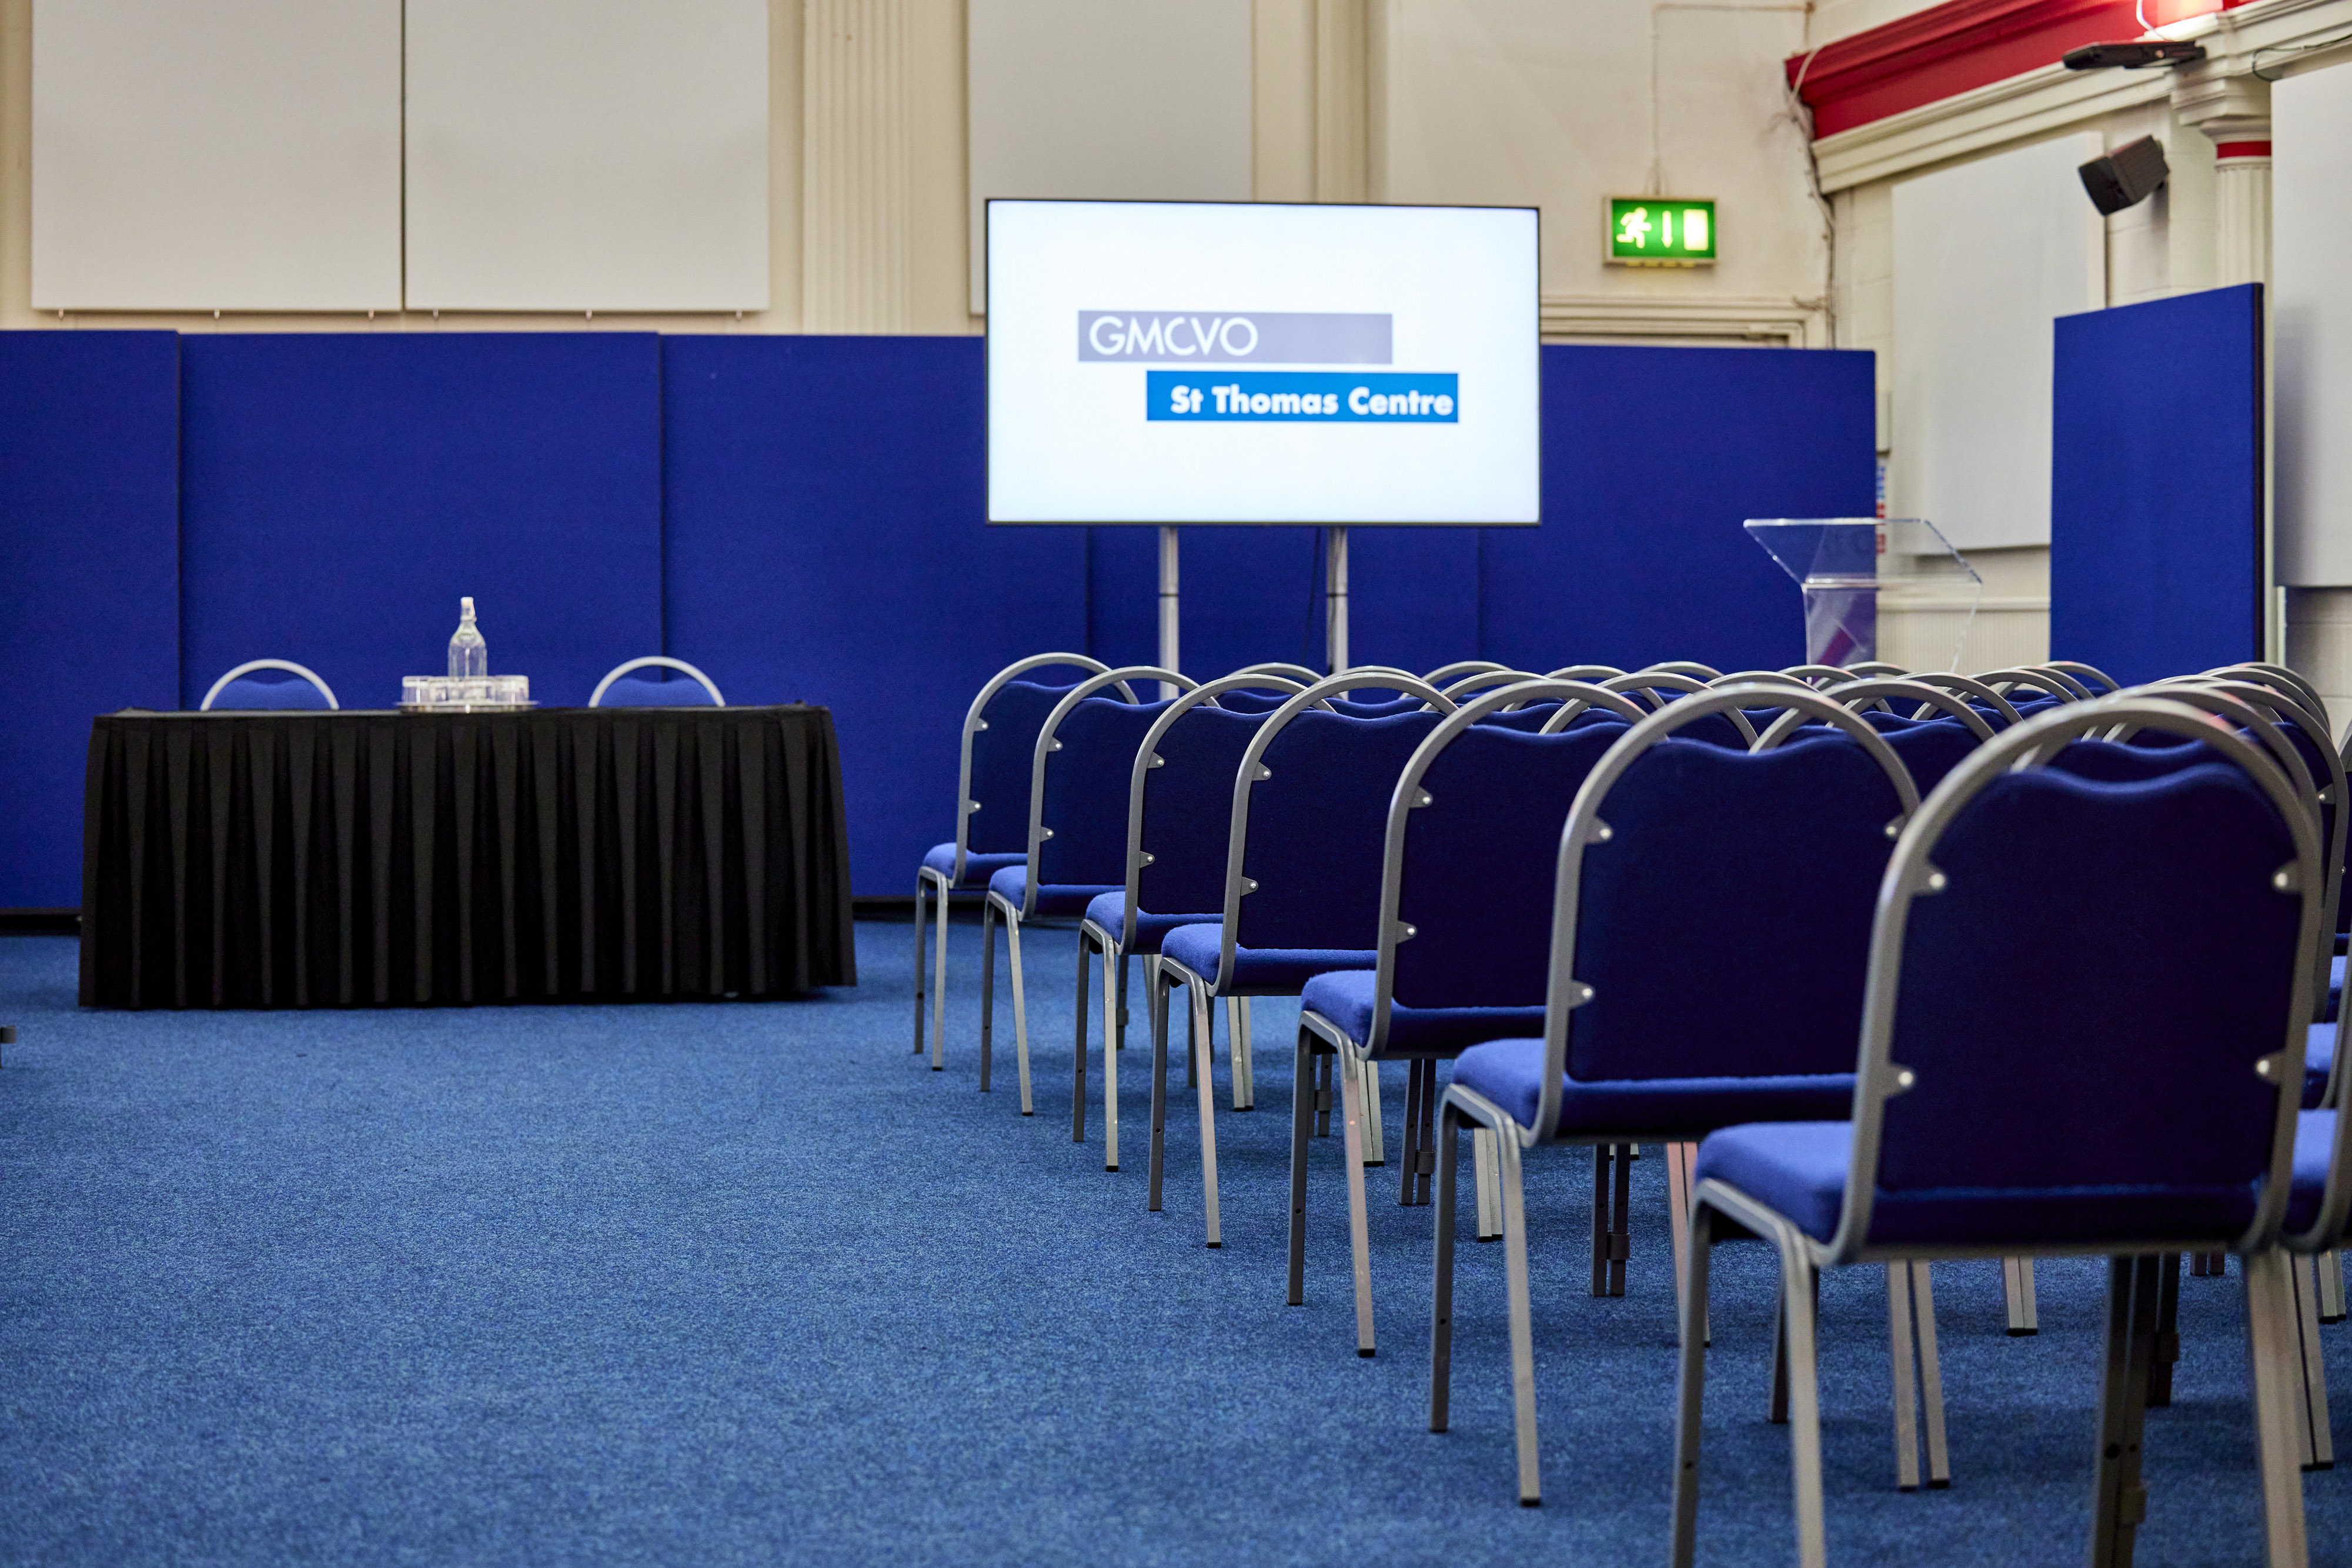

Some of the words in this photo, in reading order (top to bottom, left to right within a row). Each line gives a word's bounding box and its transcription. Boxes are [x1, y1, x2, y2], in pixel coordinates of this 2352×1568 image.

[1090, 316, 1258, 356] GMCVO
[1171, 386, 1203, 414] St
[1212, 384, 1338, 414] Thomas
[1348, 387, 1454, 415] Centre
